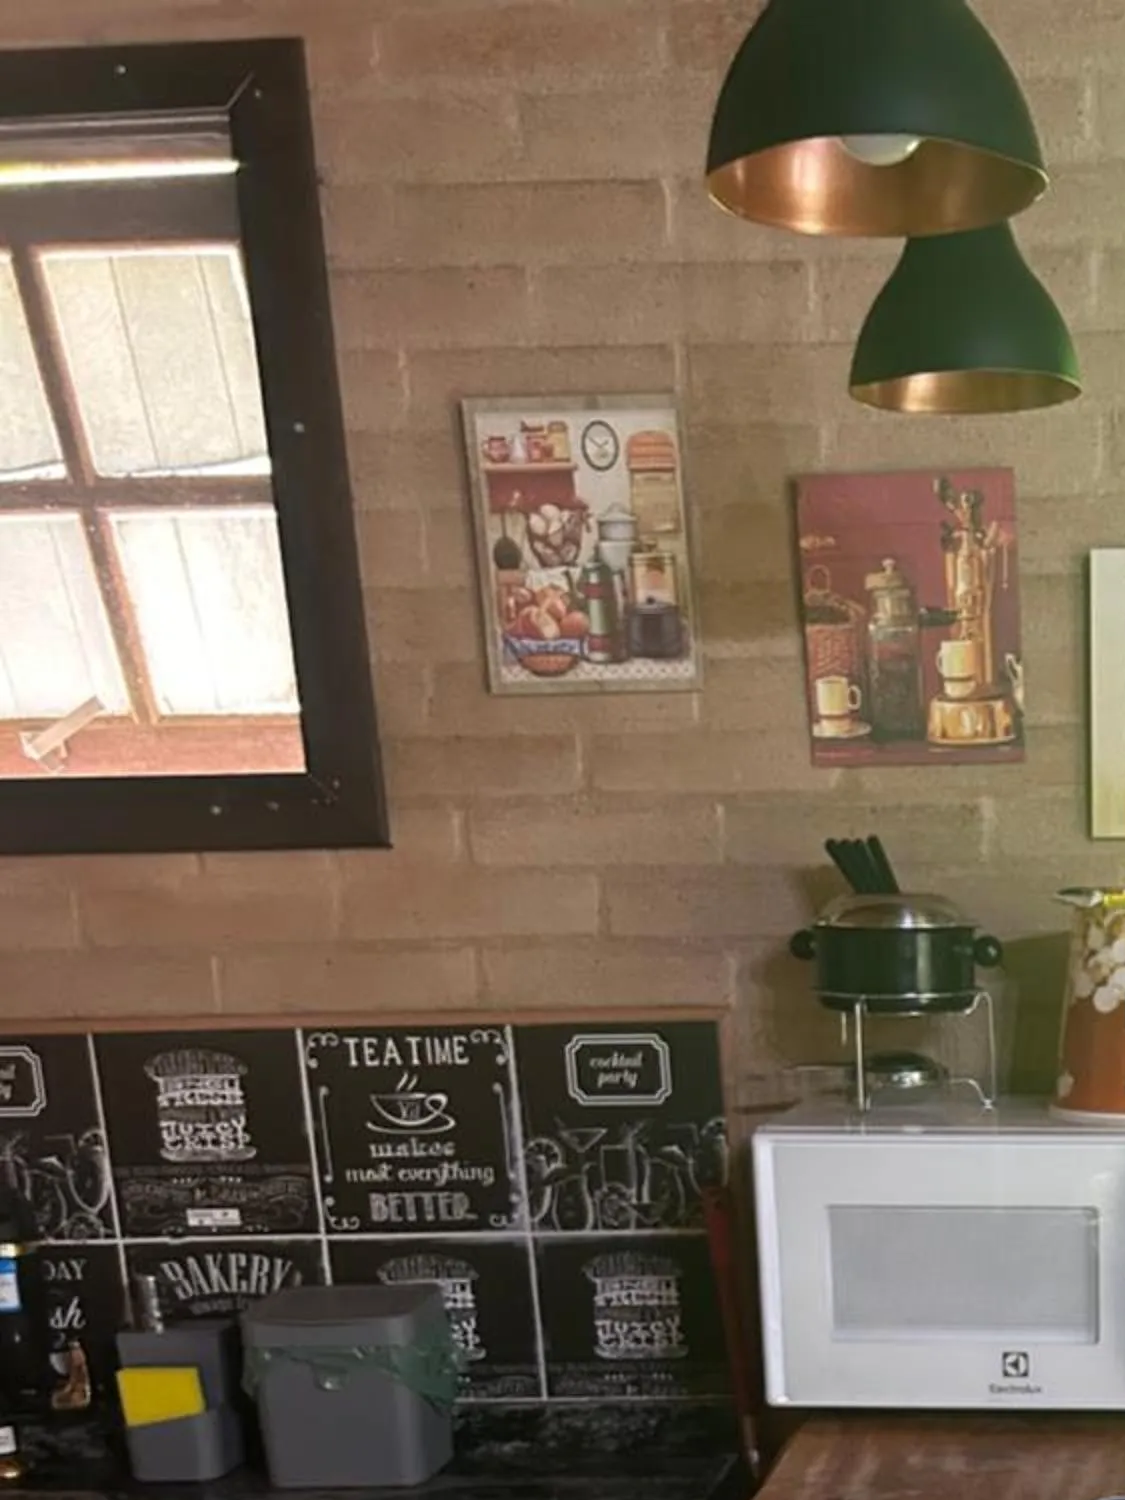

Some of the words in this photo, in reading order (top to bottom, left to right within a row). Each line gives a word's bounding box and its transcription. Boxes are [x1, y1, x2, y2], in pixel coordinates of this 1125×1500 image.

[343, 1036, 403, 1067] TEA
[405, 1036, 470, 1067] TIME
[368, 1137, 456, 1158] makes
[397, 1161, 496, 1188] everything
[368, 1192, 478, 1222] BETTER
[160, 1252, 293, 1301] BAKERY
